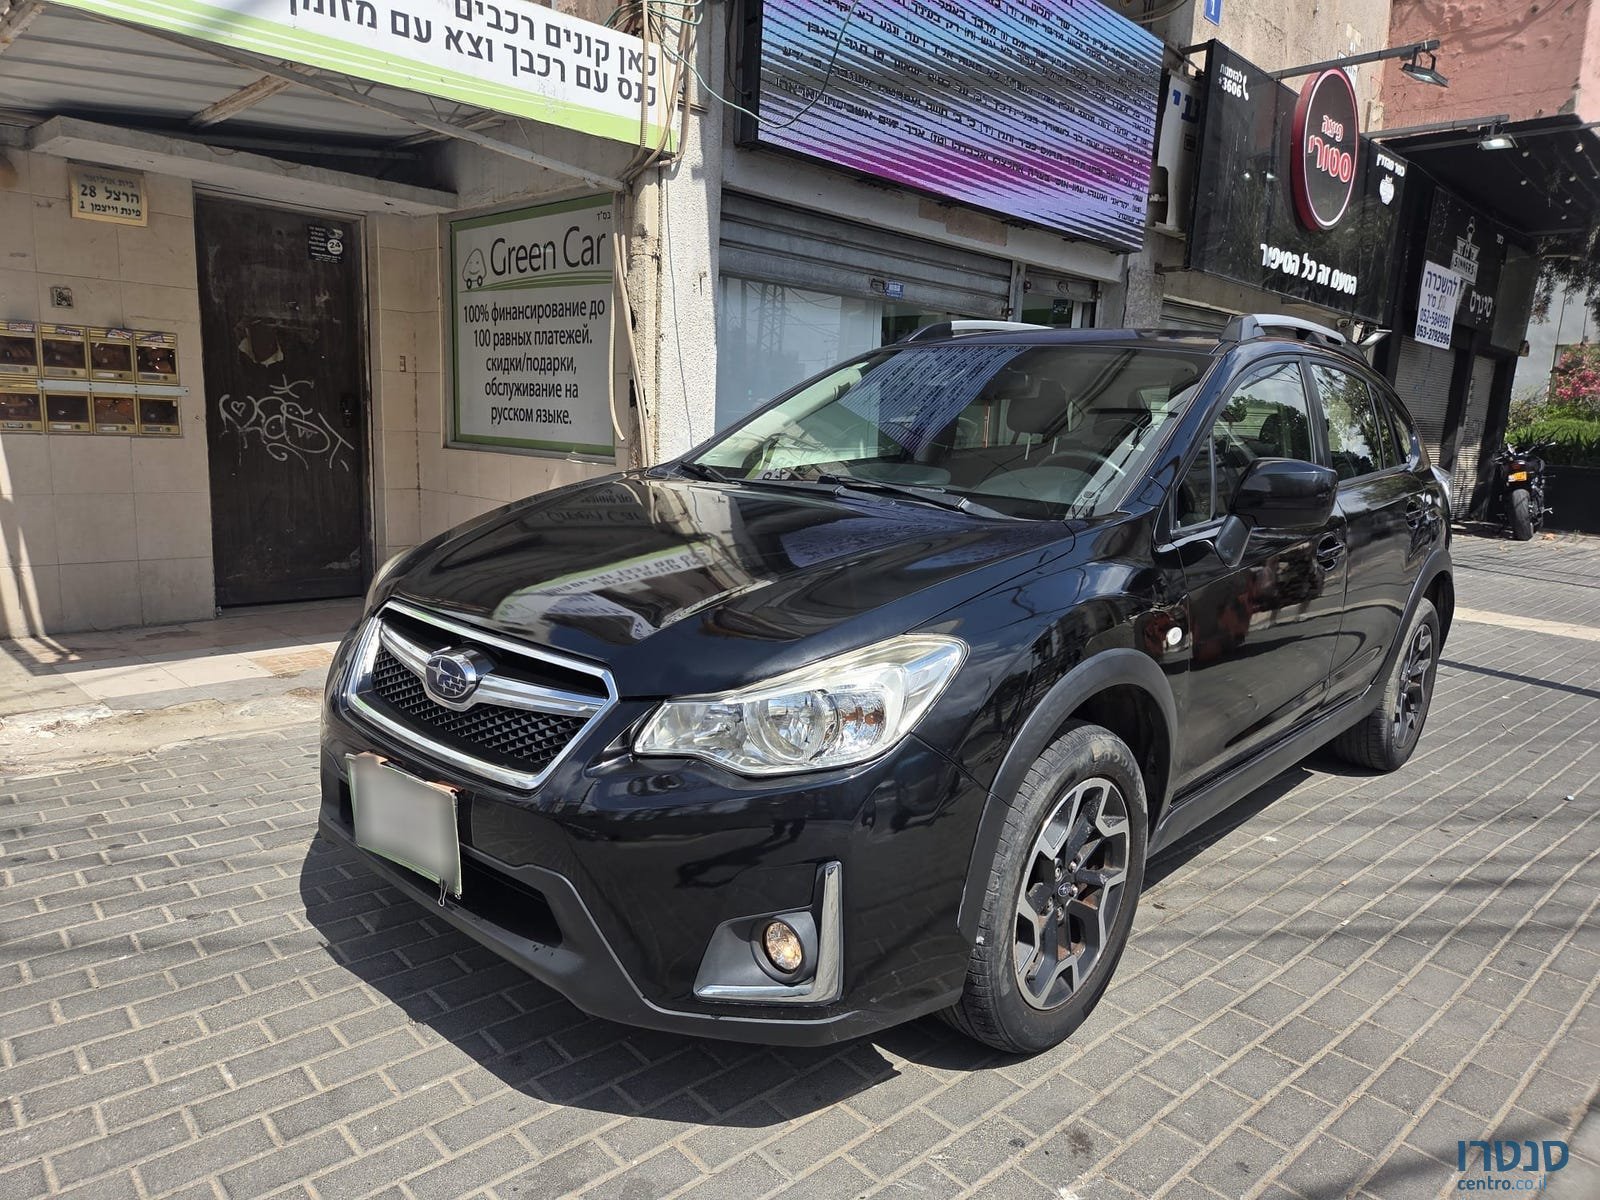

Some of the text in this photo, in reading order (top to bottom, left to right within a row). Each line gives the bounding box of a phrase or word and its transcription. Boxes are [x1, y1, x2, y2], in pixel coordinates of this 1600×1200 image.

[391, 9, 431, 43] עם
[455, 0, 656, 76] כאן קונים רכבים
[444, 26, 494, 62] וצא
[503, 43, 565, 82] רכבך
[576, 64, 608, 93] עם
[617, 77, 656, 106] כנס
[1308, 135, 1352, 183] סטורי
[80, 184, 140, 204] הרצל 28
[80, 200, 85, 209] 1
[120, 206, 141, 217] פינת
[490, 226, 606, 276] Green Car
[1260, 243, 1358, 296] הטעם זה כל הסיפור
[1424, 271, 1459, 298] להשכרה
[463, 299, 605, 326] 100% финансирование до
[473, 323, 593, 351] 100 равных платежей.
[486, 352, 577, 377] скидки/подарки,
[485, 377, 579, 401] обслуживание на
[490, 406, 572, 425] русском языке.
